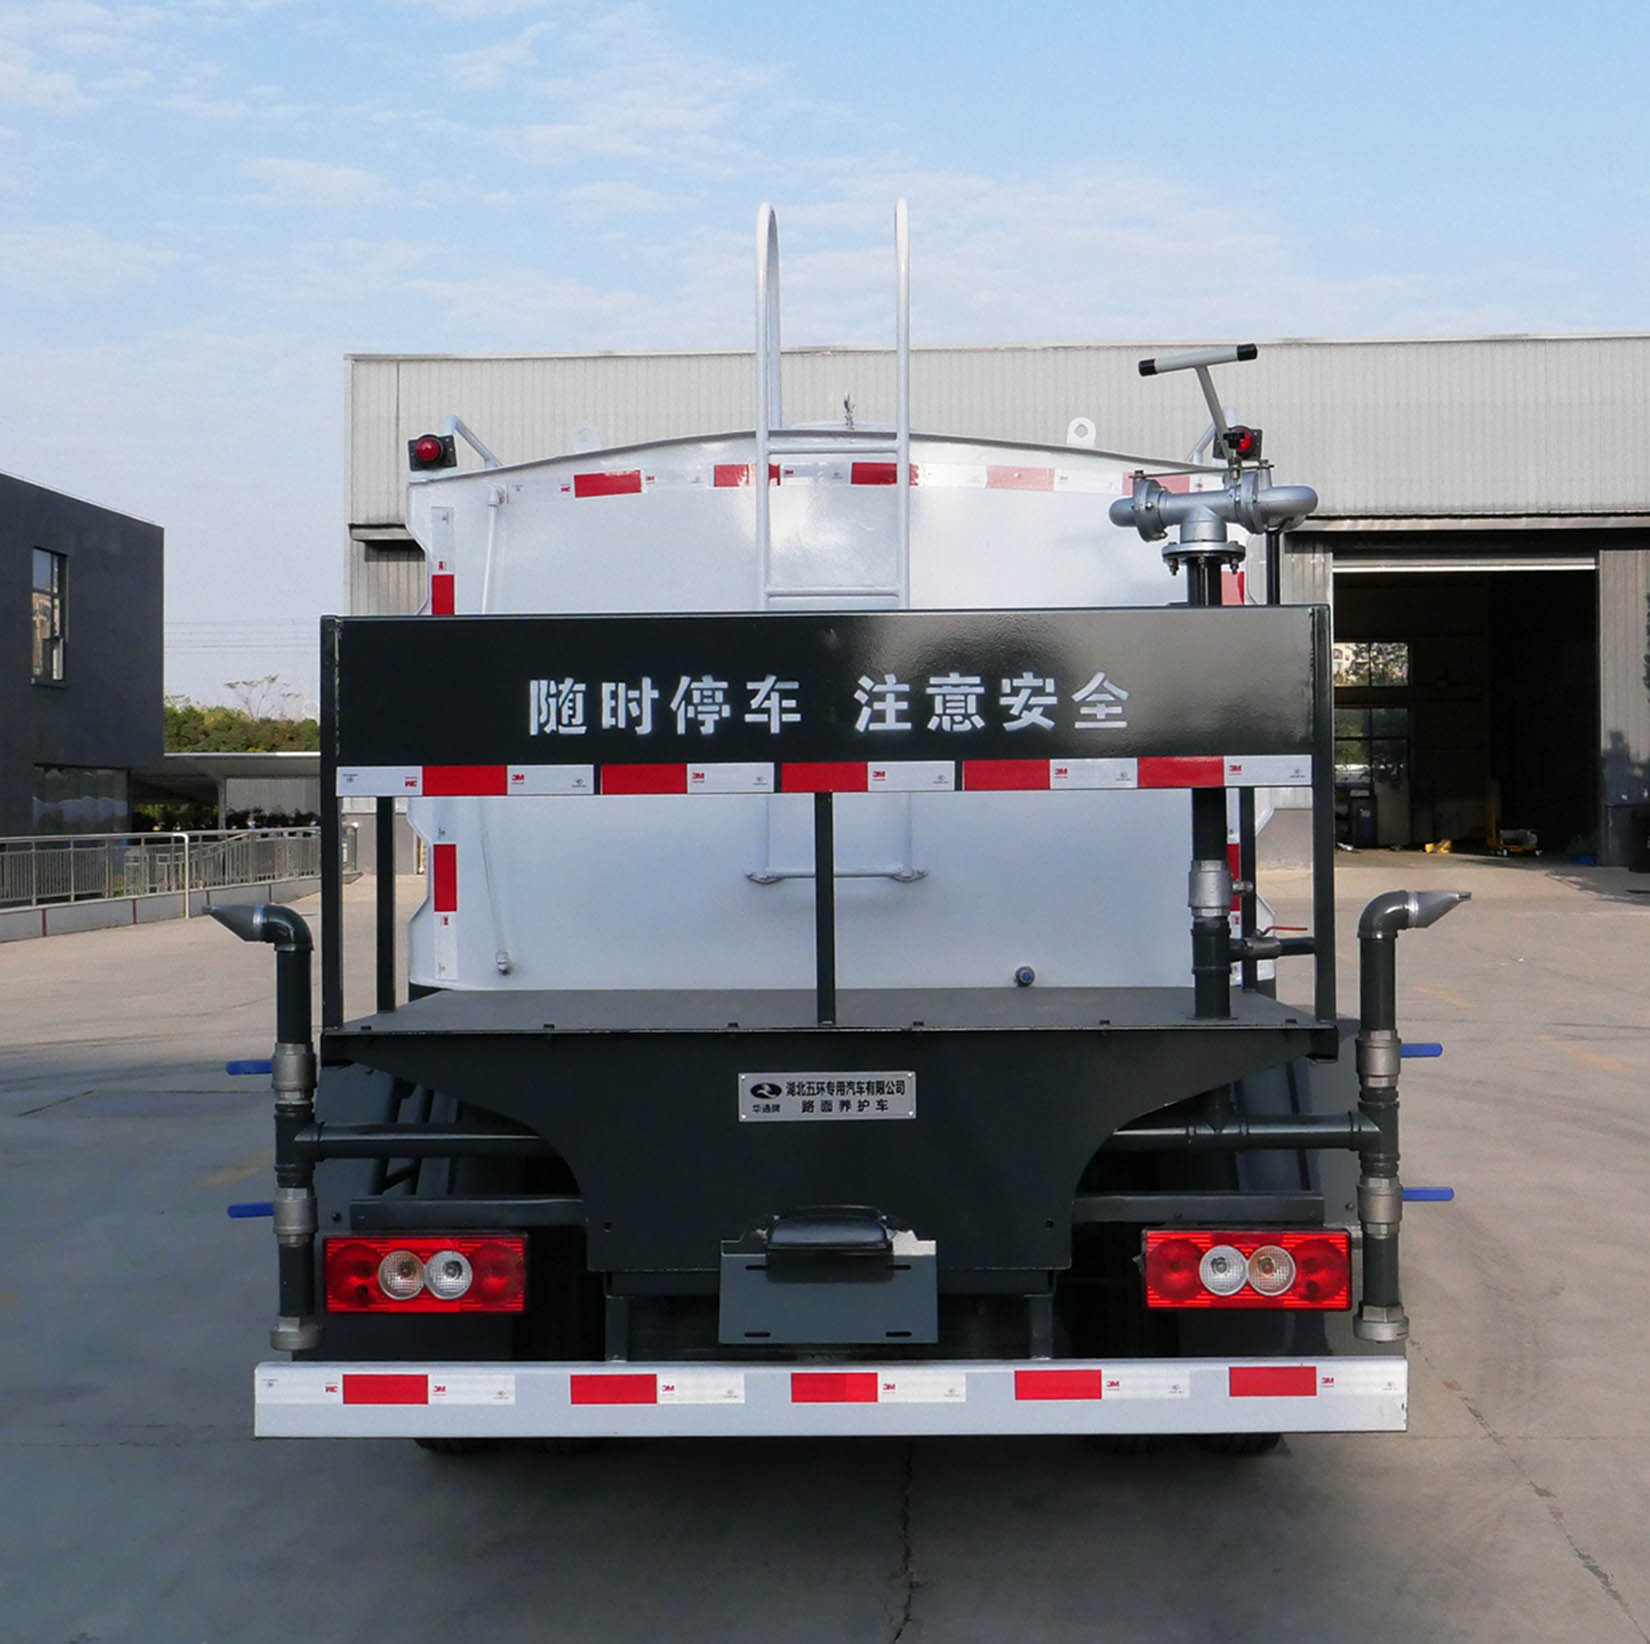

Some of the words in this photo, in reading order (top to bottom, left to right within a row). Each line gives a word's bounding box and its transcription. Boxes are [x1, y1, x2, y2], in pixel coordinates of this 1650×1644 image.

[529, 675, 802, 736] 随时停车
[854, 671, 1129, 732] 注意安全
[785, 1080, 905, 1097] 湖北五环专用汽车有限公司
[801, 1099, 888, 1113] 路面养护车
